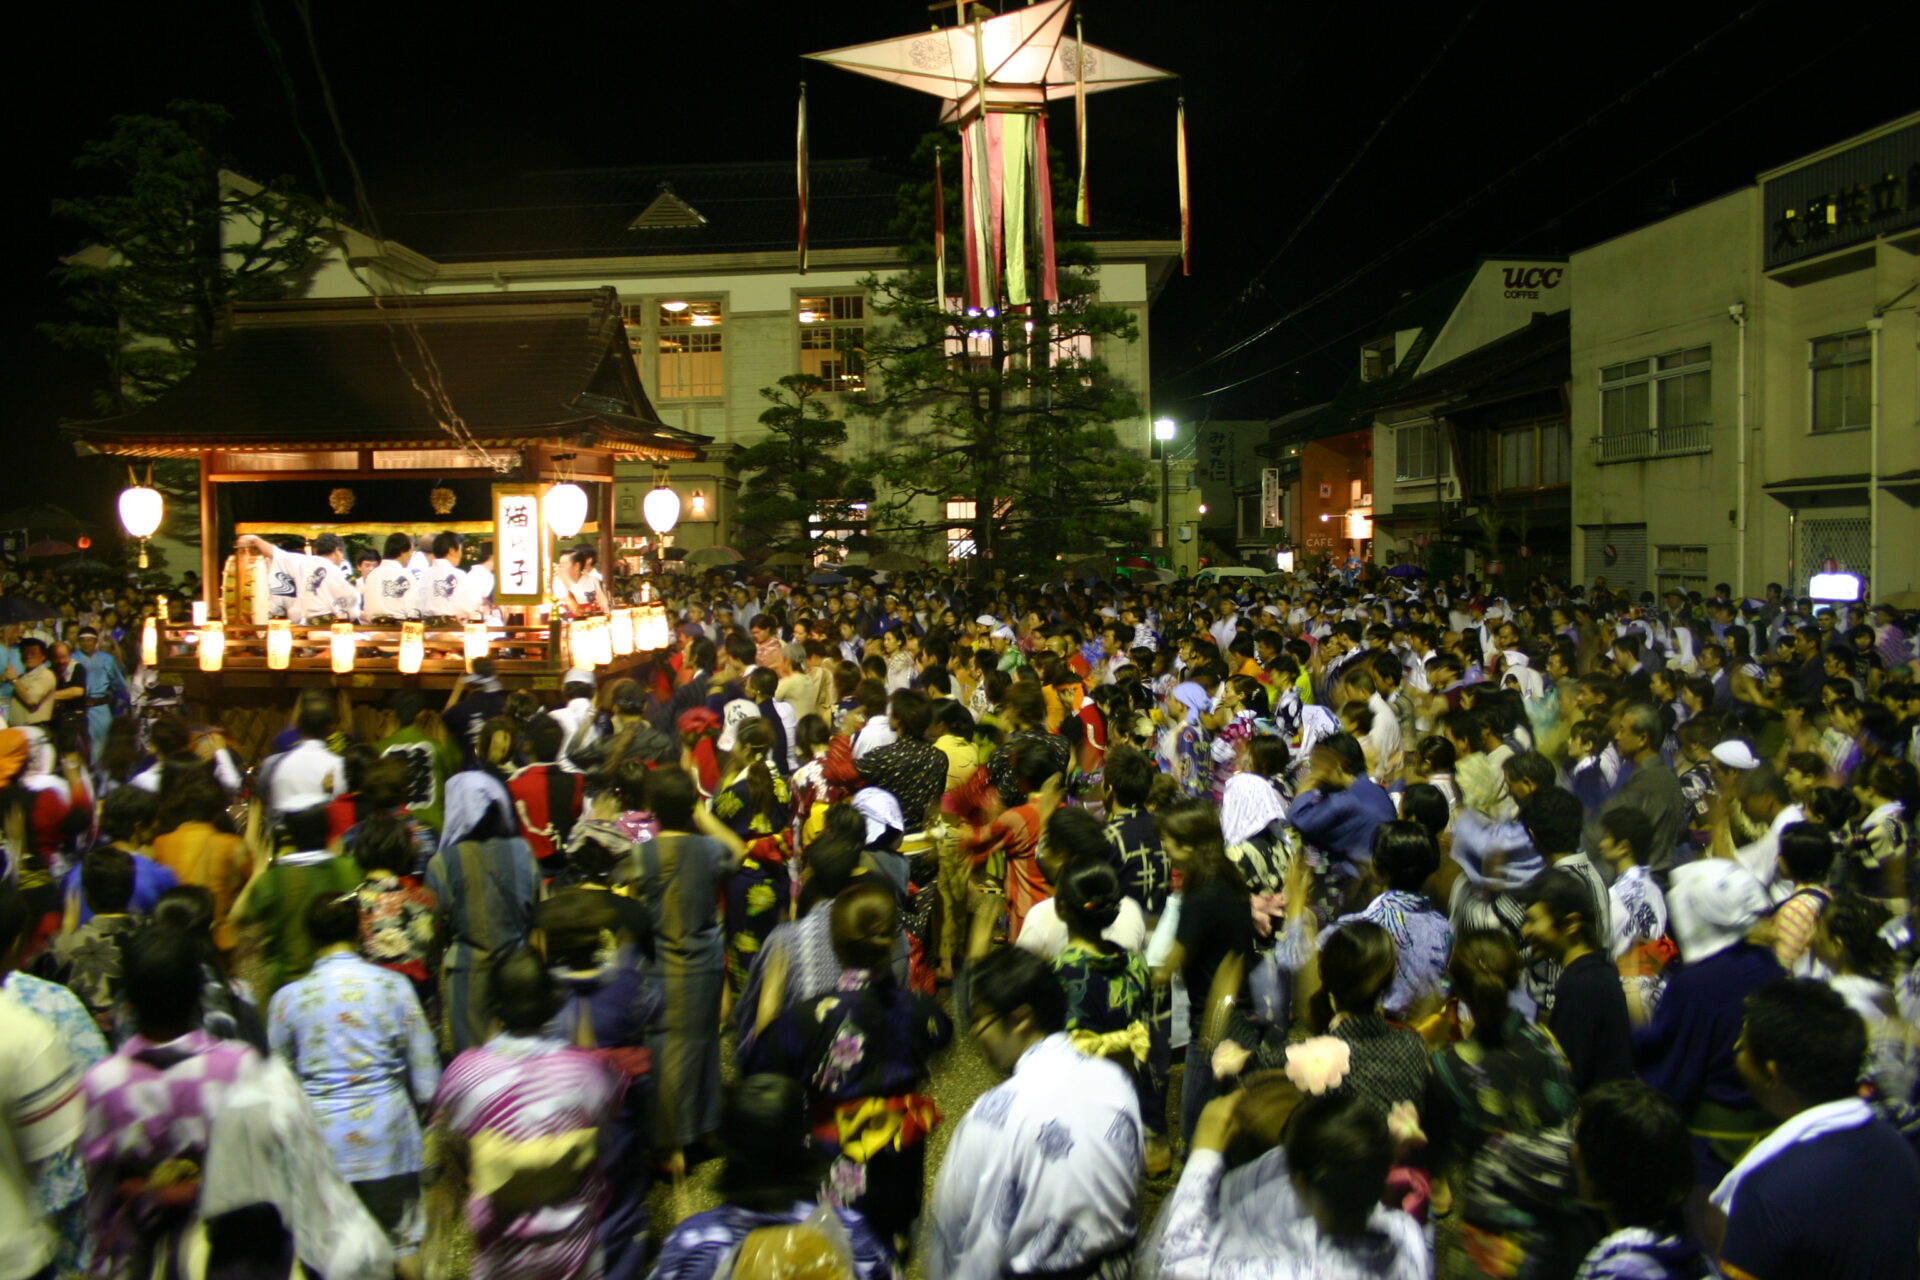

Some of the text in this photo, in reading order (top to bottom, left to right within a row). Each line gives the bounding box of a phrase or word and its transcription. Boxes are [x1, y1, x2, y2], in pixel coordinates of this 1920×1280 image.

[1502, 267, 1564, 289] UCC
[1503, 290, 1540, 300] COFFEE
[1305, 537, 1334, 547] CAFE
